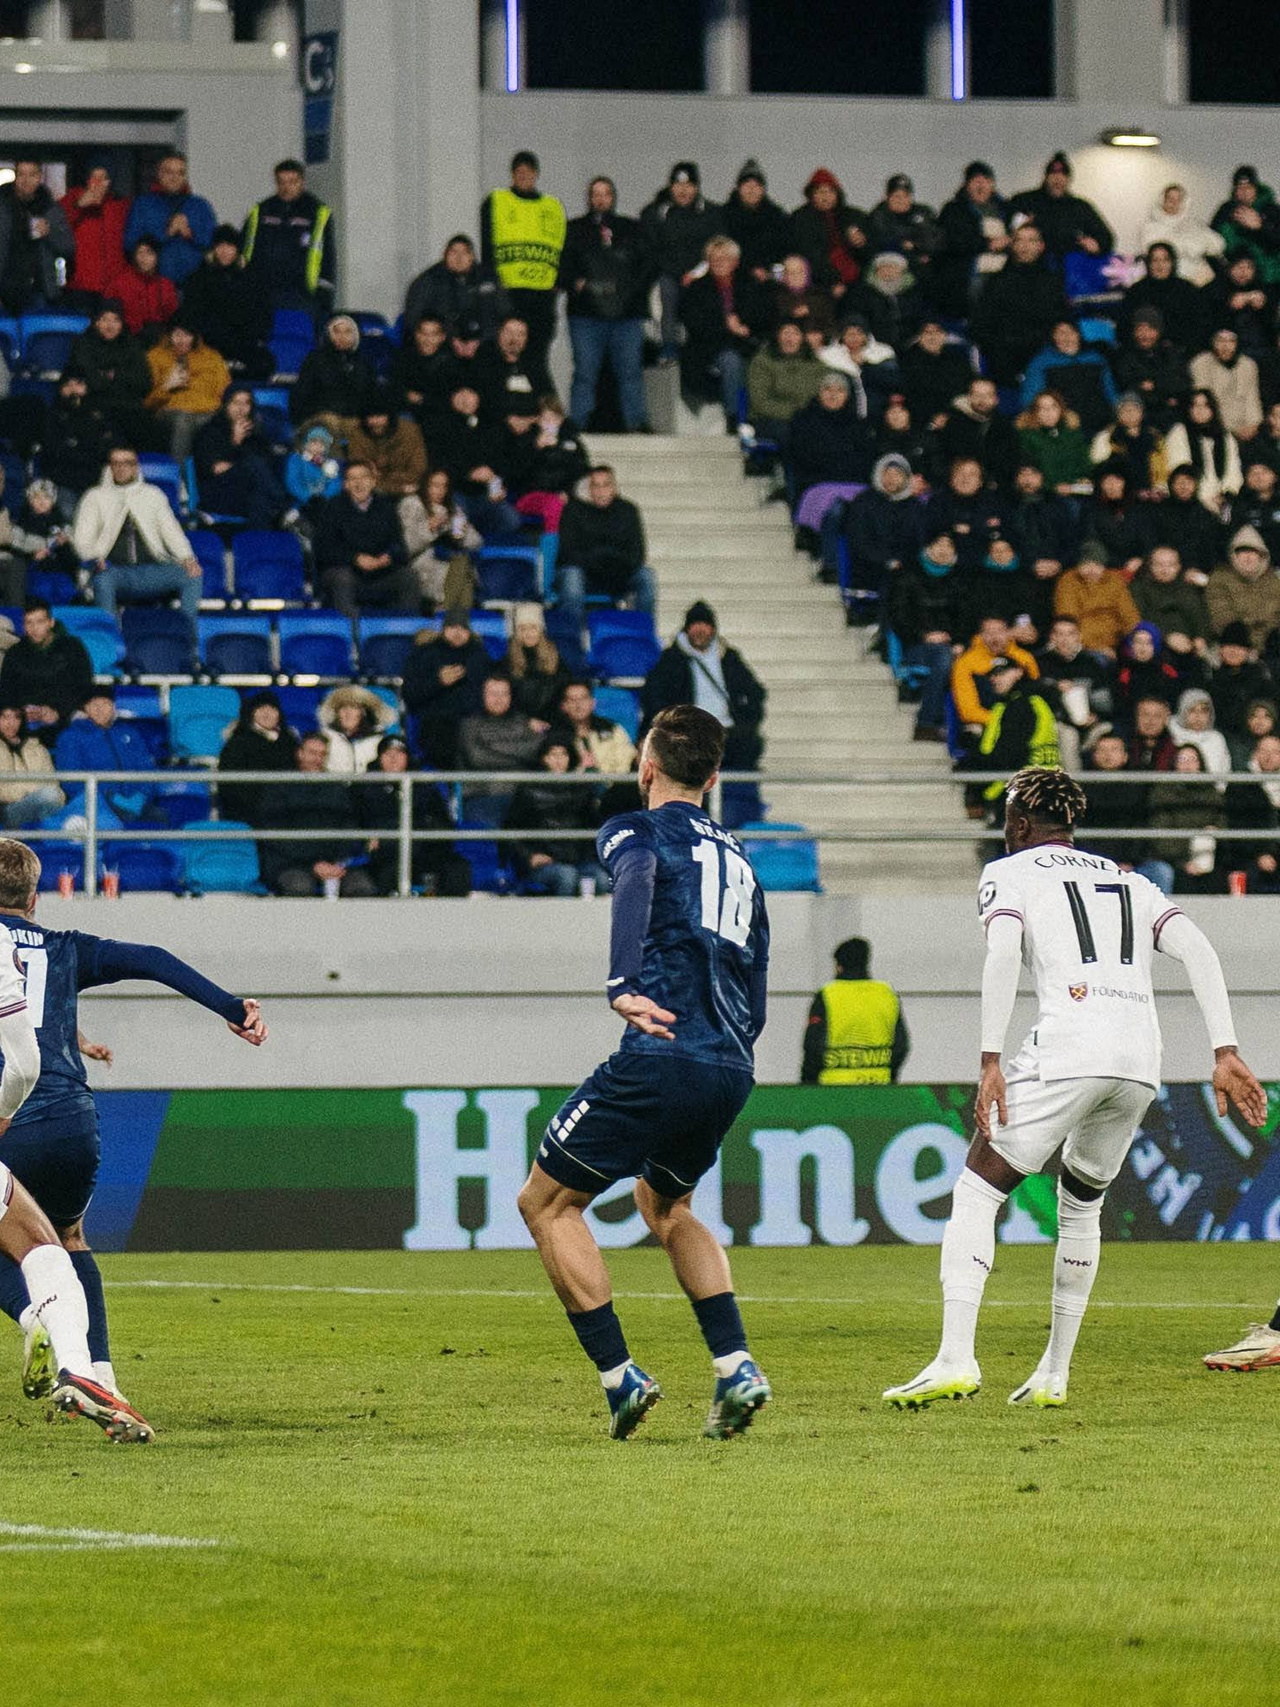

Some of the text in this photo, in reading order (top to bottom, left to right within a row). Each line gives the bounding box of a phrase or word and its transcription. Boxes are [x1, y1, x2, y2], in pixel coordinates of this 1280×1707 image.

[692, 838, 756, 948] 18
[1063, 881, 1134, 965] 17
[1063, 1256, 1093, 1267] WHU
